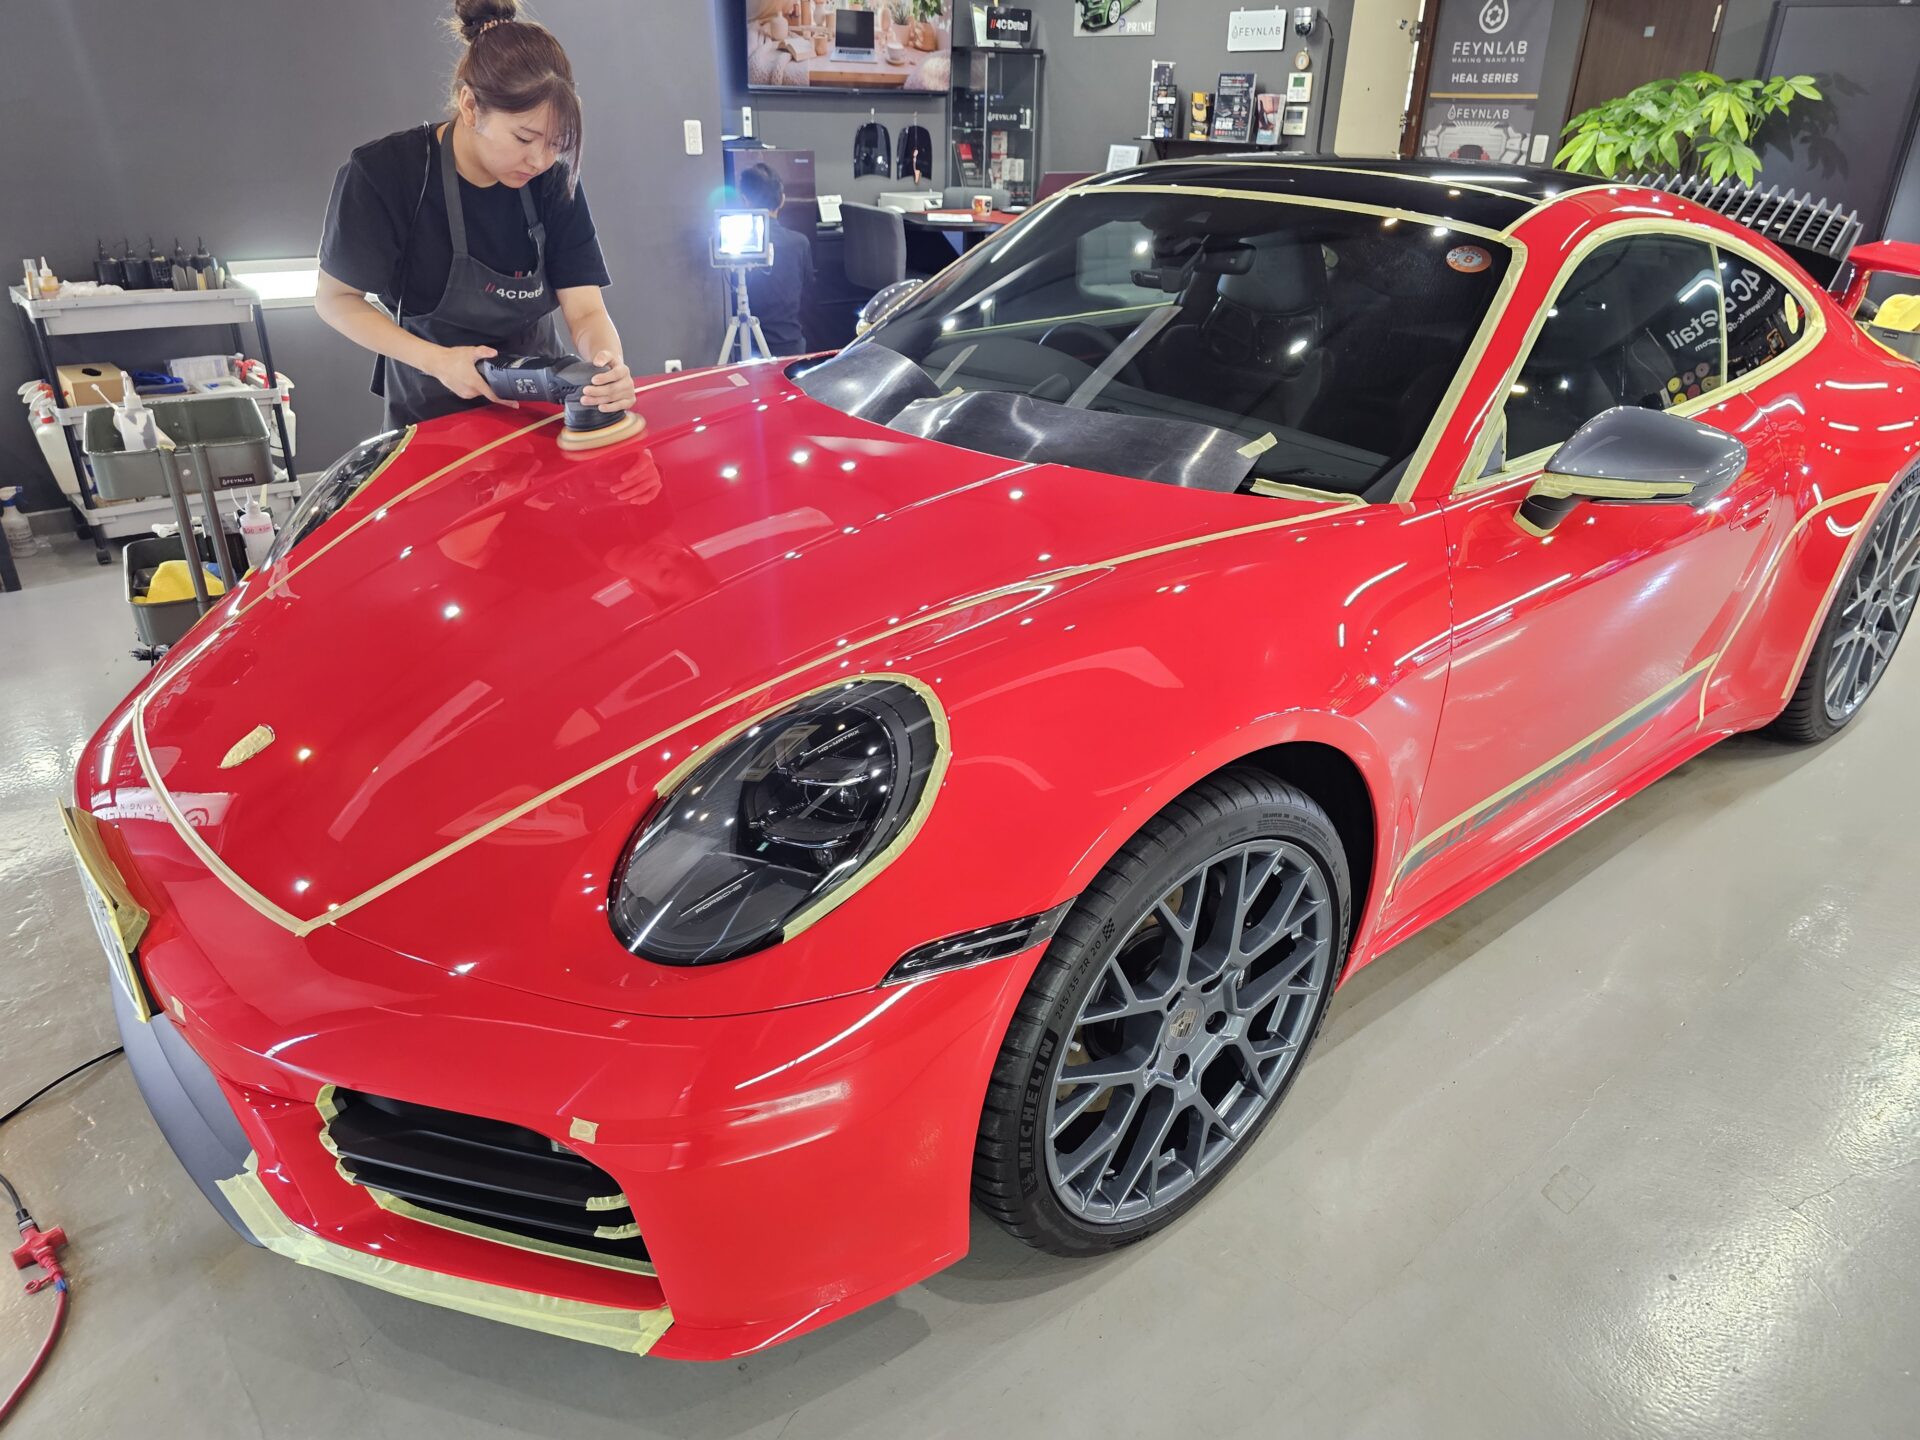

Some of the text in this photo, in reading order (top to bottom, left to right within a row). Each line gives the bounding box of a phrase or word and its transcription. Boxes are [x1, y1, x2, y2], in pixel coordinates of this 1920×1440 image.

[1007, 19, 1029, 31] Detail
[1126, 21, 1152, 32] PRIME
[1239, 26, 1281, 36] FEYNLAB
[1452, 40, 1528, 56] FEYNLAB
[1451, 73, 1519, 84] HEAL SERIES
[1456, 108, 1510, 119] FEYNLAB
[695, 883, 743, 914] PORSCHE
[1079, 958, 1091, 975] ZR
[1091, 940, 1103, 957] 20
[1019, 1037, 1055, 1169] MICHELIN
